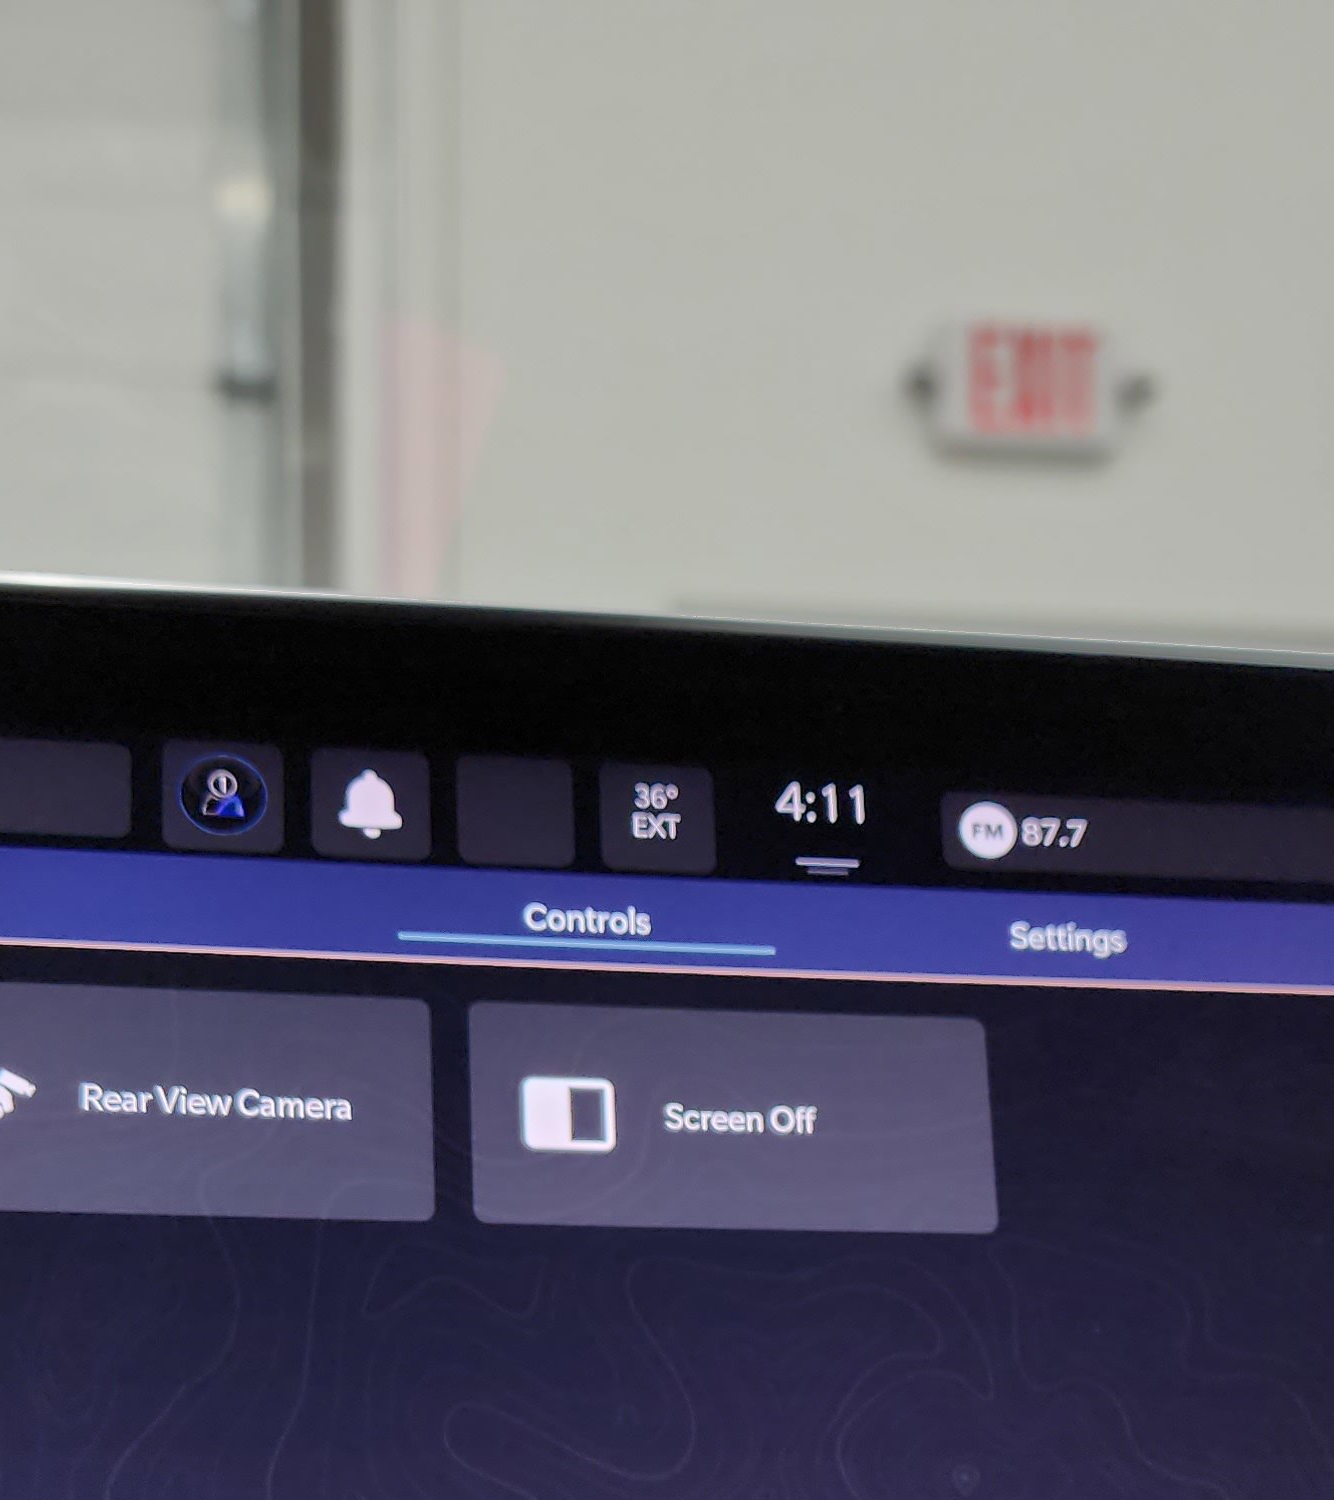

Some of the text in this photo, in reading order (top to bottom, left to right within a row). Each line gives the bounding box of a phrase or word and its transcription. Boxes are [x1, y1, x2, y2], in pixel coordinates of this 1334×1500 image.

[775, 781, 866, 825] 4:11
[632, 813, 681, 840] EXT
[972, 821, 1004, 841] FM
[1021, 818, 1088, 849] 87.7
[523, 902, 652, 937] Controls
[1009, 921, 1127, 958] Settings
[79, 1082, 353, 1122] Rear View Camera
[665, 1102, 817, 1136] Screen Off
